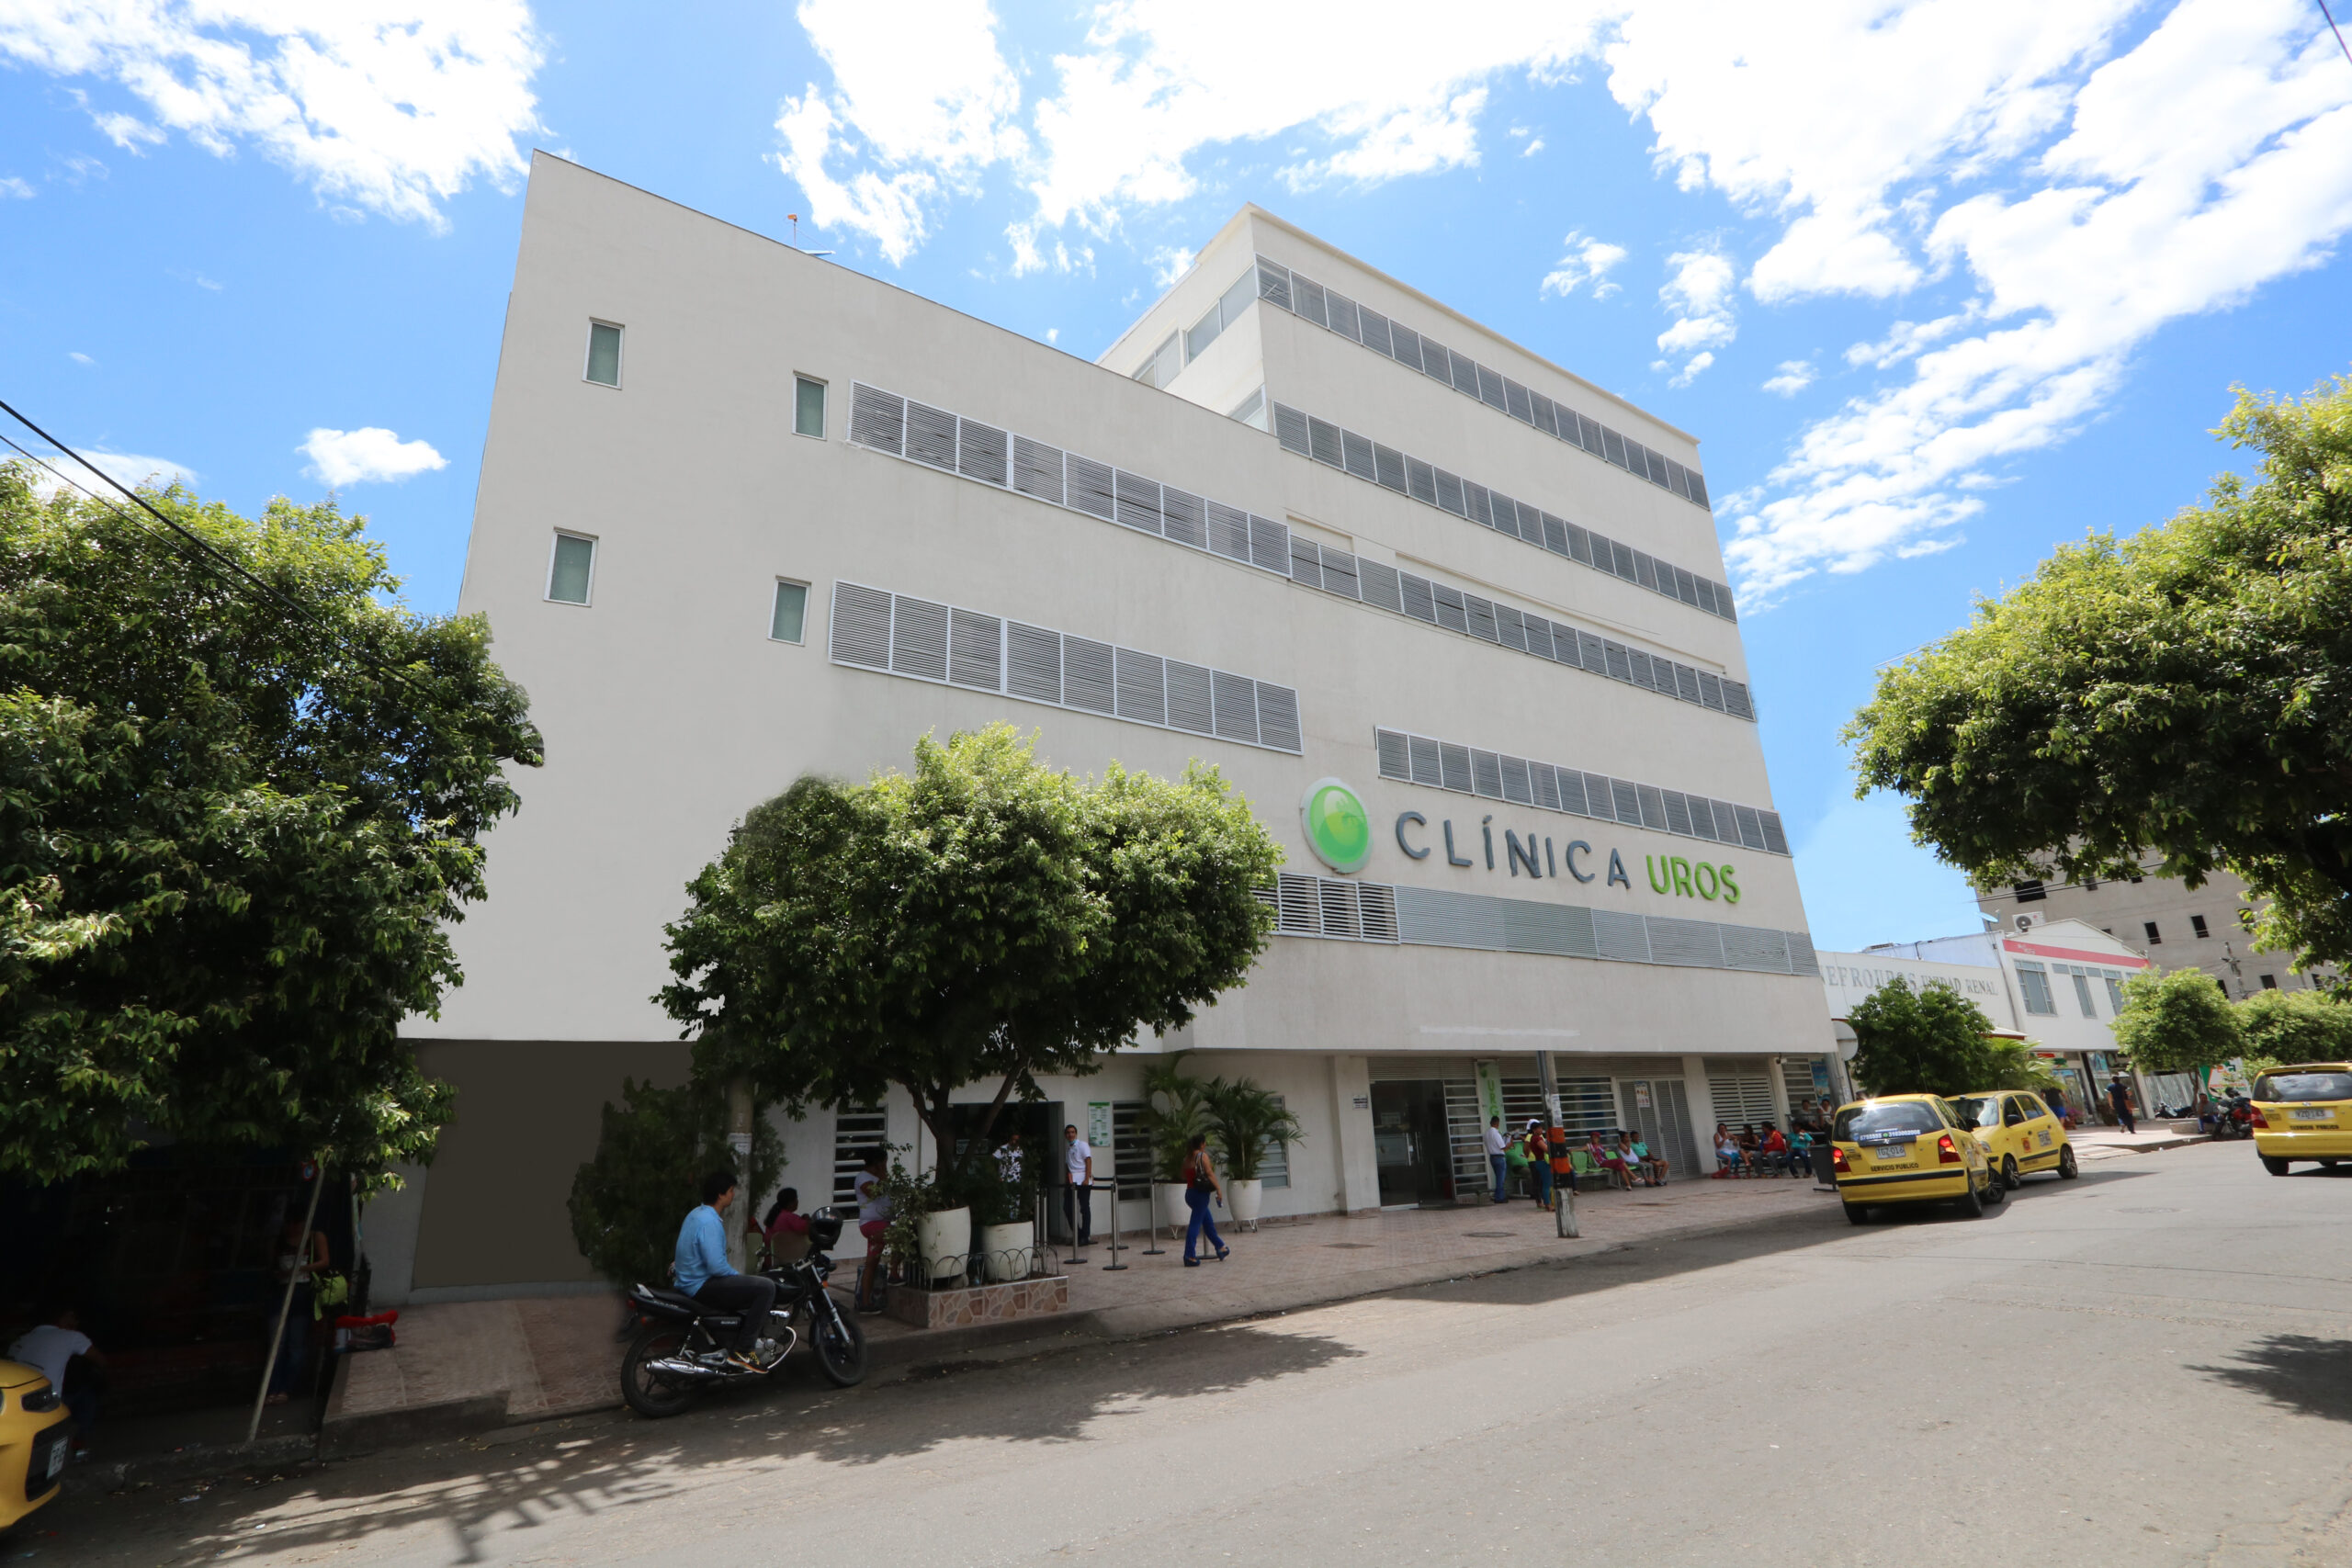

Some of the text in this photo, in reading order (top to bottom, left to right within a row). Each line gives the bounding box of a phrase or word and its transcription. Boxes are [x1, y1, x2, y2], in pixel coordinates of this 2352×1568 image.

[1395, 811, 1741, 904] CLÍNICA UROS
[1965, 978, 1998, 996] RENAL
[1871, 1162, 1919, 1172] SERVICIO PUBLICO
